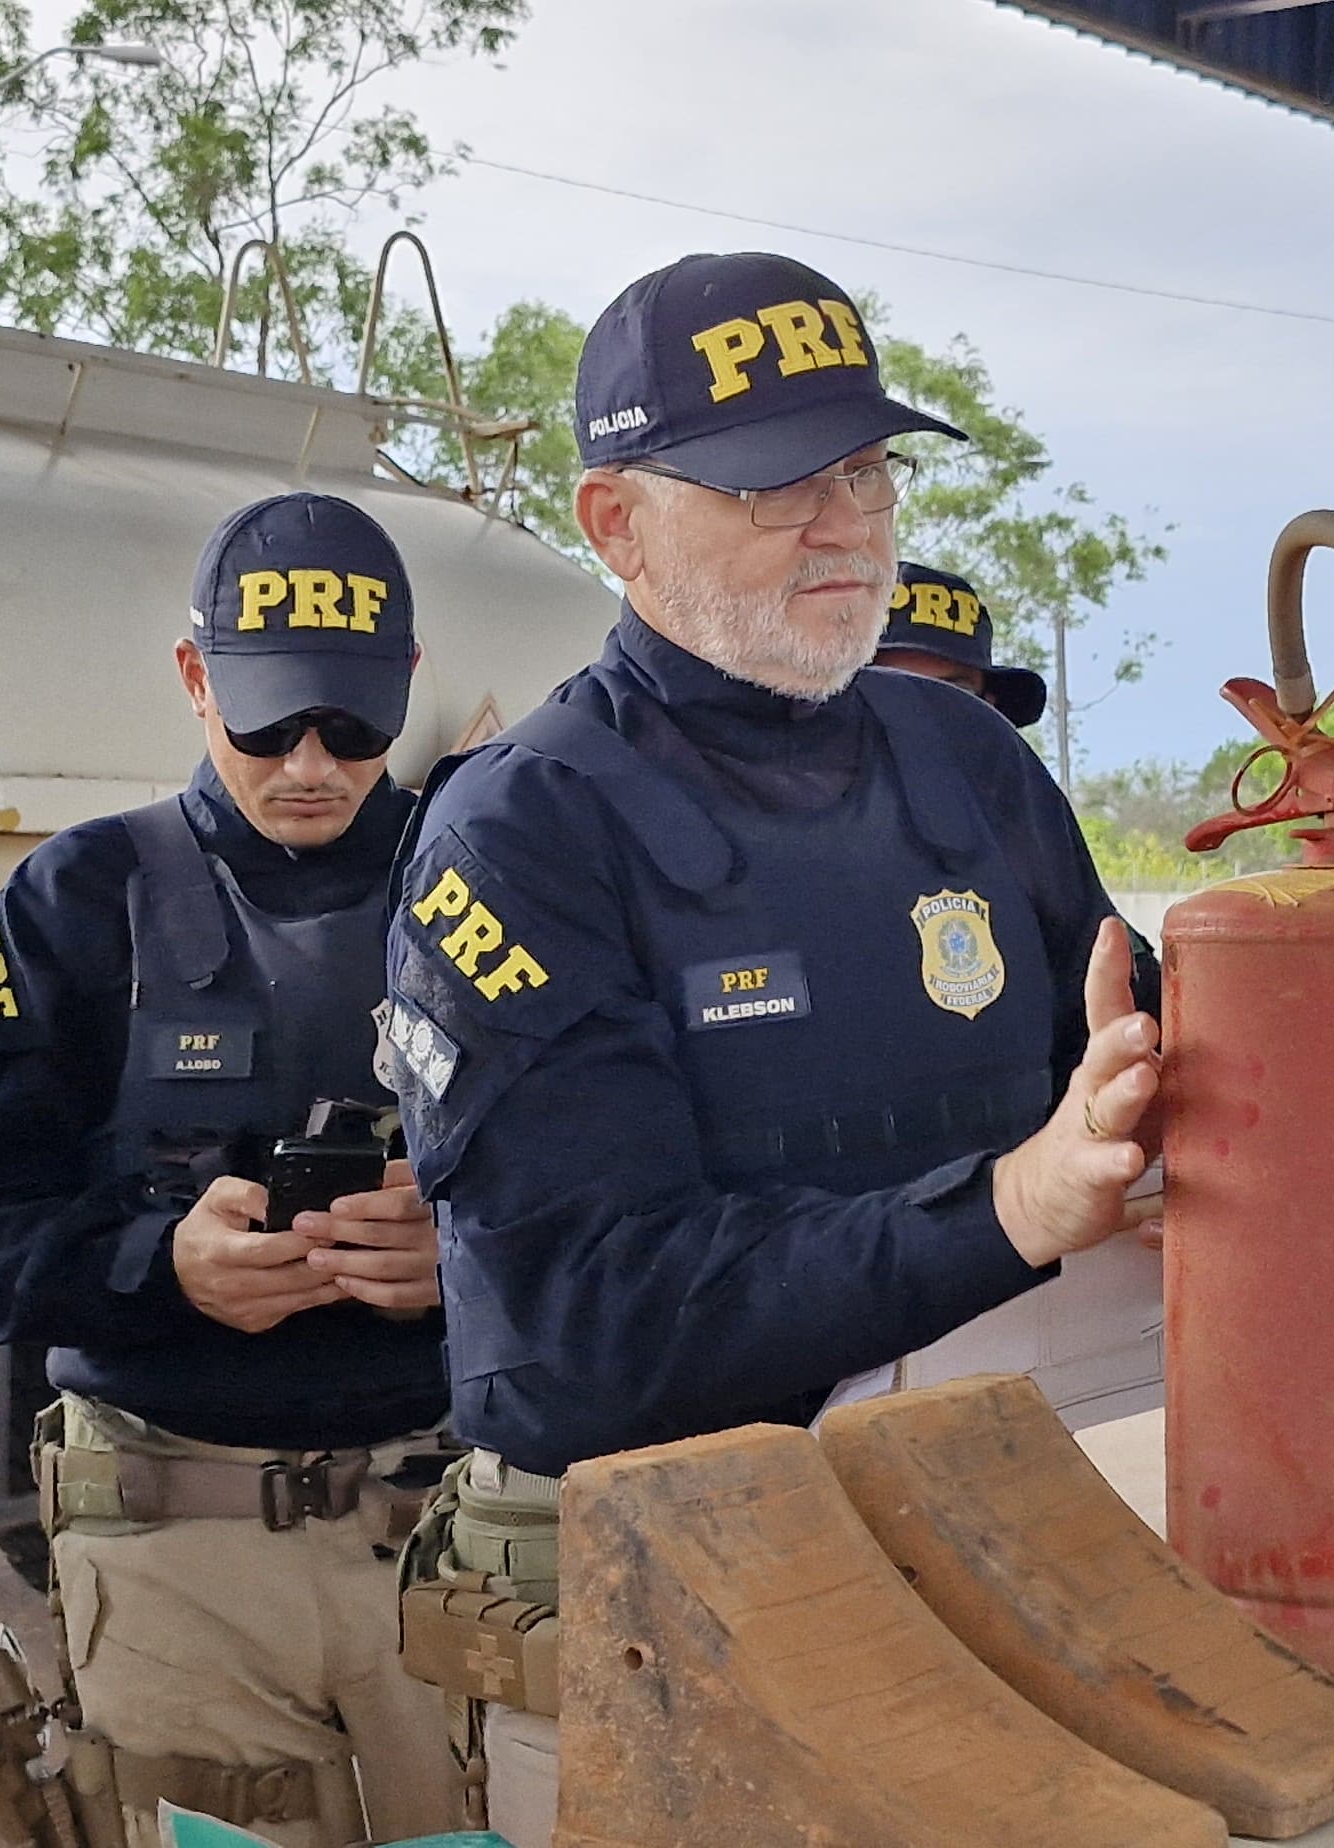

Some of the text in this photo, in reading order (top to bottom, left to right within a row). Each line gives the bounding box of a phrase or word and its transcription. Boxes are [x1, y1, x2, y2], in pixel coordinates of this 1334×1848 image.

[691, 298, 868, 403] PRF
[237, 568, 387, 633] PRF
[412, 867, 550, 1002] PRF
[720, 967, 769, 994] PRF
[702, 997, 795, 1023] KLEBSON
[179, 1034, 220, 1051] PRF
